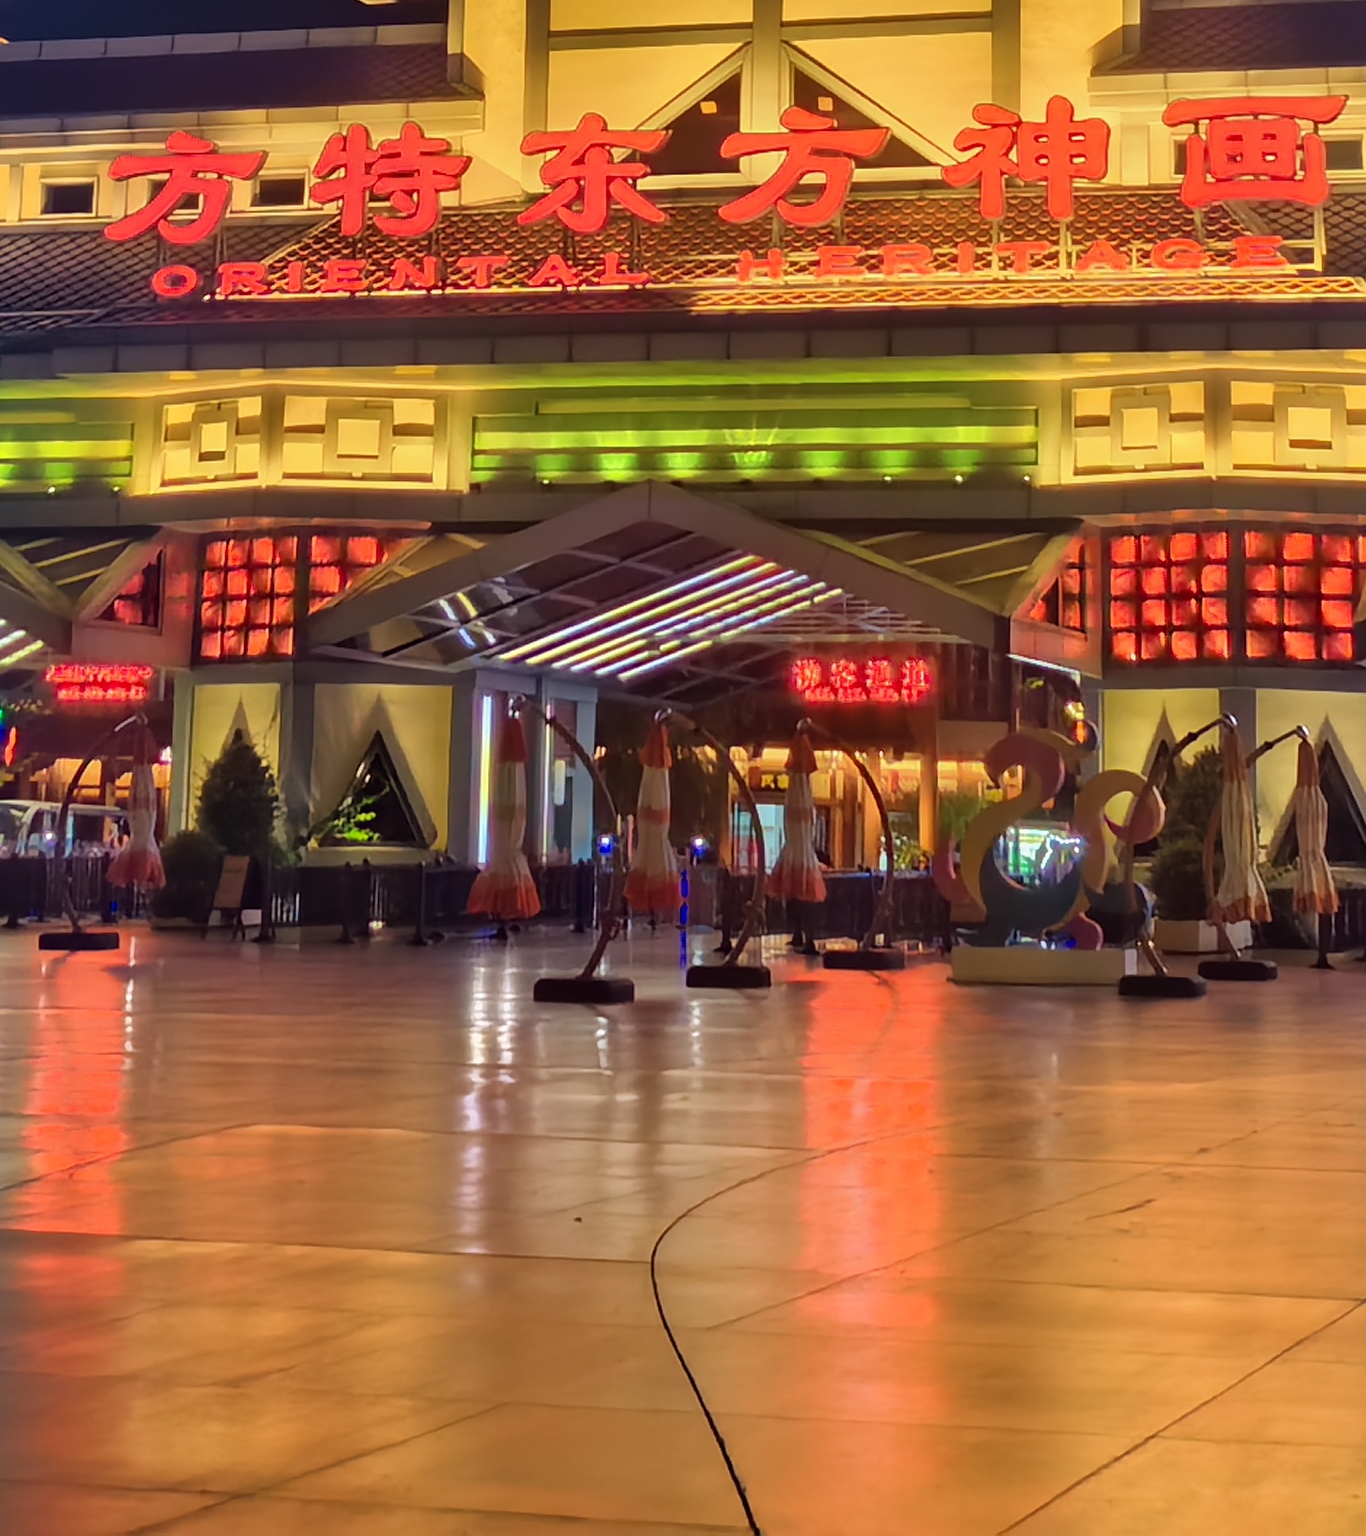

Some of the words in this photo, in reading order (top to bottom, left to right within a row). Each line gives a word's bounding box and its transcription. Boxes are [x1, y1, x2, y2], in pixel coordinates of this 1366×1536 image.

[102, 95, 1349, 245] 方特东方神画
[151, 251, 650, 297] ORIENTAL
[736, 235, 1290, 283] HERITAGE
